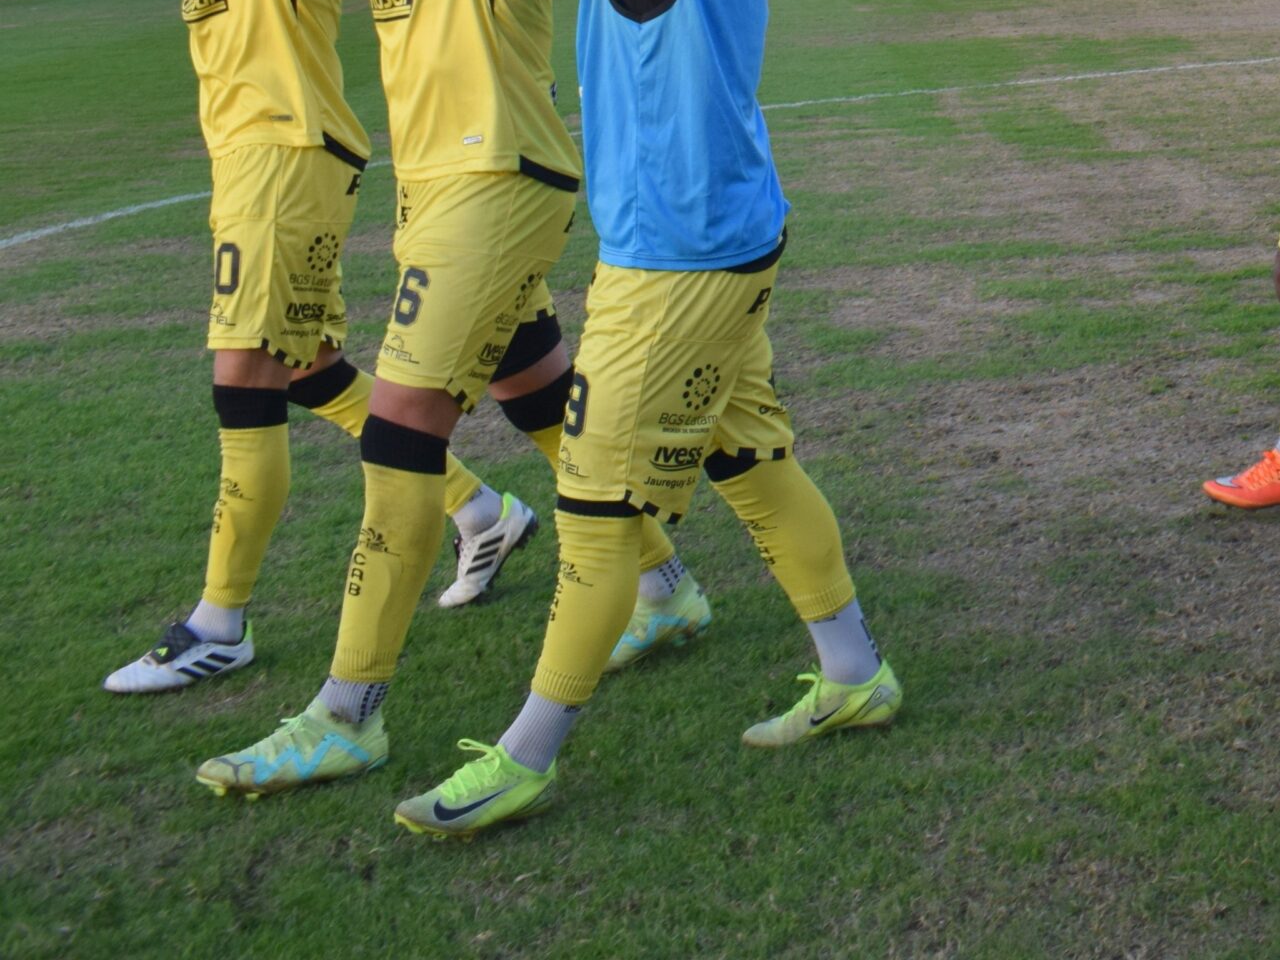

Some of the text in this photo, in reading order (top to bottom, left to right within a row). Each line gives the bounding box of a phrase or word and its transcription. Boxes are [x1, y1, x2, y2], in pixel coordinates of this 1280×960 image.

[394, 267, 430, 327] 6
[658, 412, 684, 426] BGS
[348, 552, 367, 597] CAB
